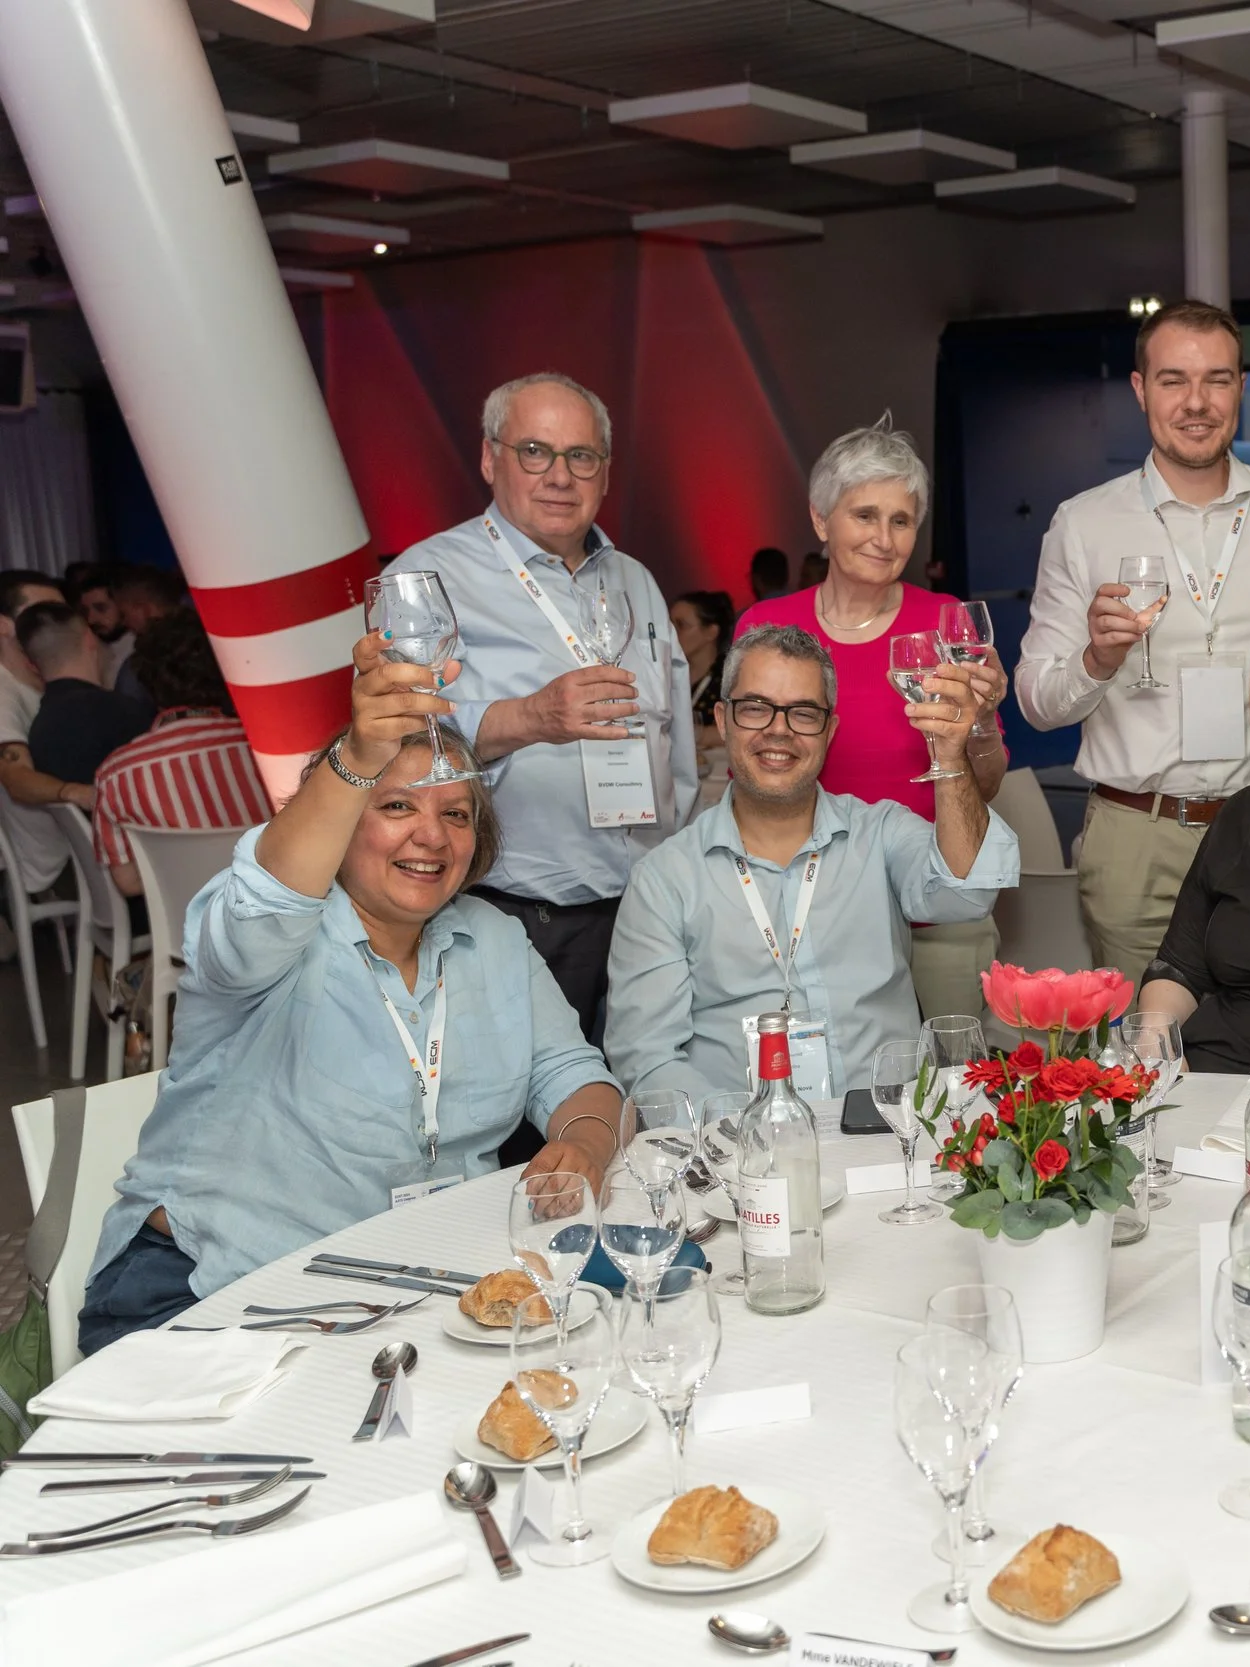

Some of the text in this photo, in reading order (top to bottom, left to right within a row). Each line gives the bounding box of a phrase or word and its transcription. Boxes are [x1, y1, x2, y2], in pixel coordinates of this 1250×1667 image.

[1232, 517, 1242, 535] ECM
[526, 580, 541, 598] ECM
[1187, 573, 1198, 592] ECM
[1210, 582, 1220, 600] ECM
[573, 644, 588, 663] ECM
[807, 863, 816, 882] ECM
[764, 928, 776, 948] ECM
[430, 1040, 438, 1066] ECM
[414, 1070, 427, 1097] ECM
[741, 1208, 780, 1225] ATILLES
[802, 1648, 831, 1663] Mme
